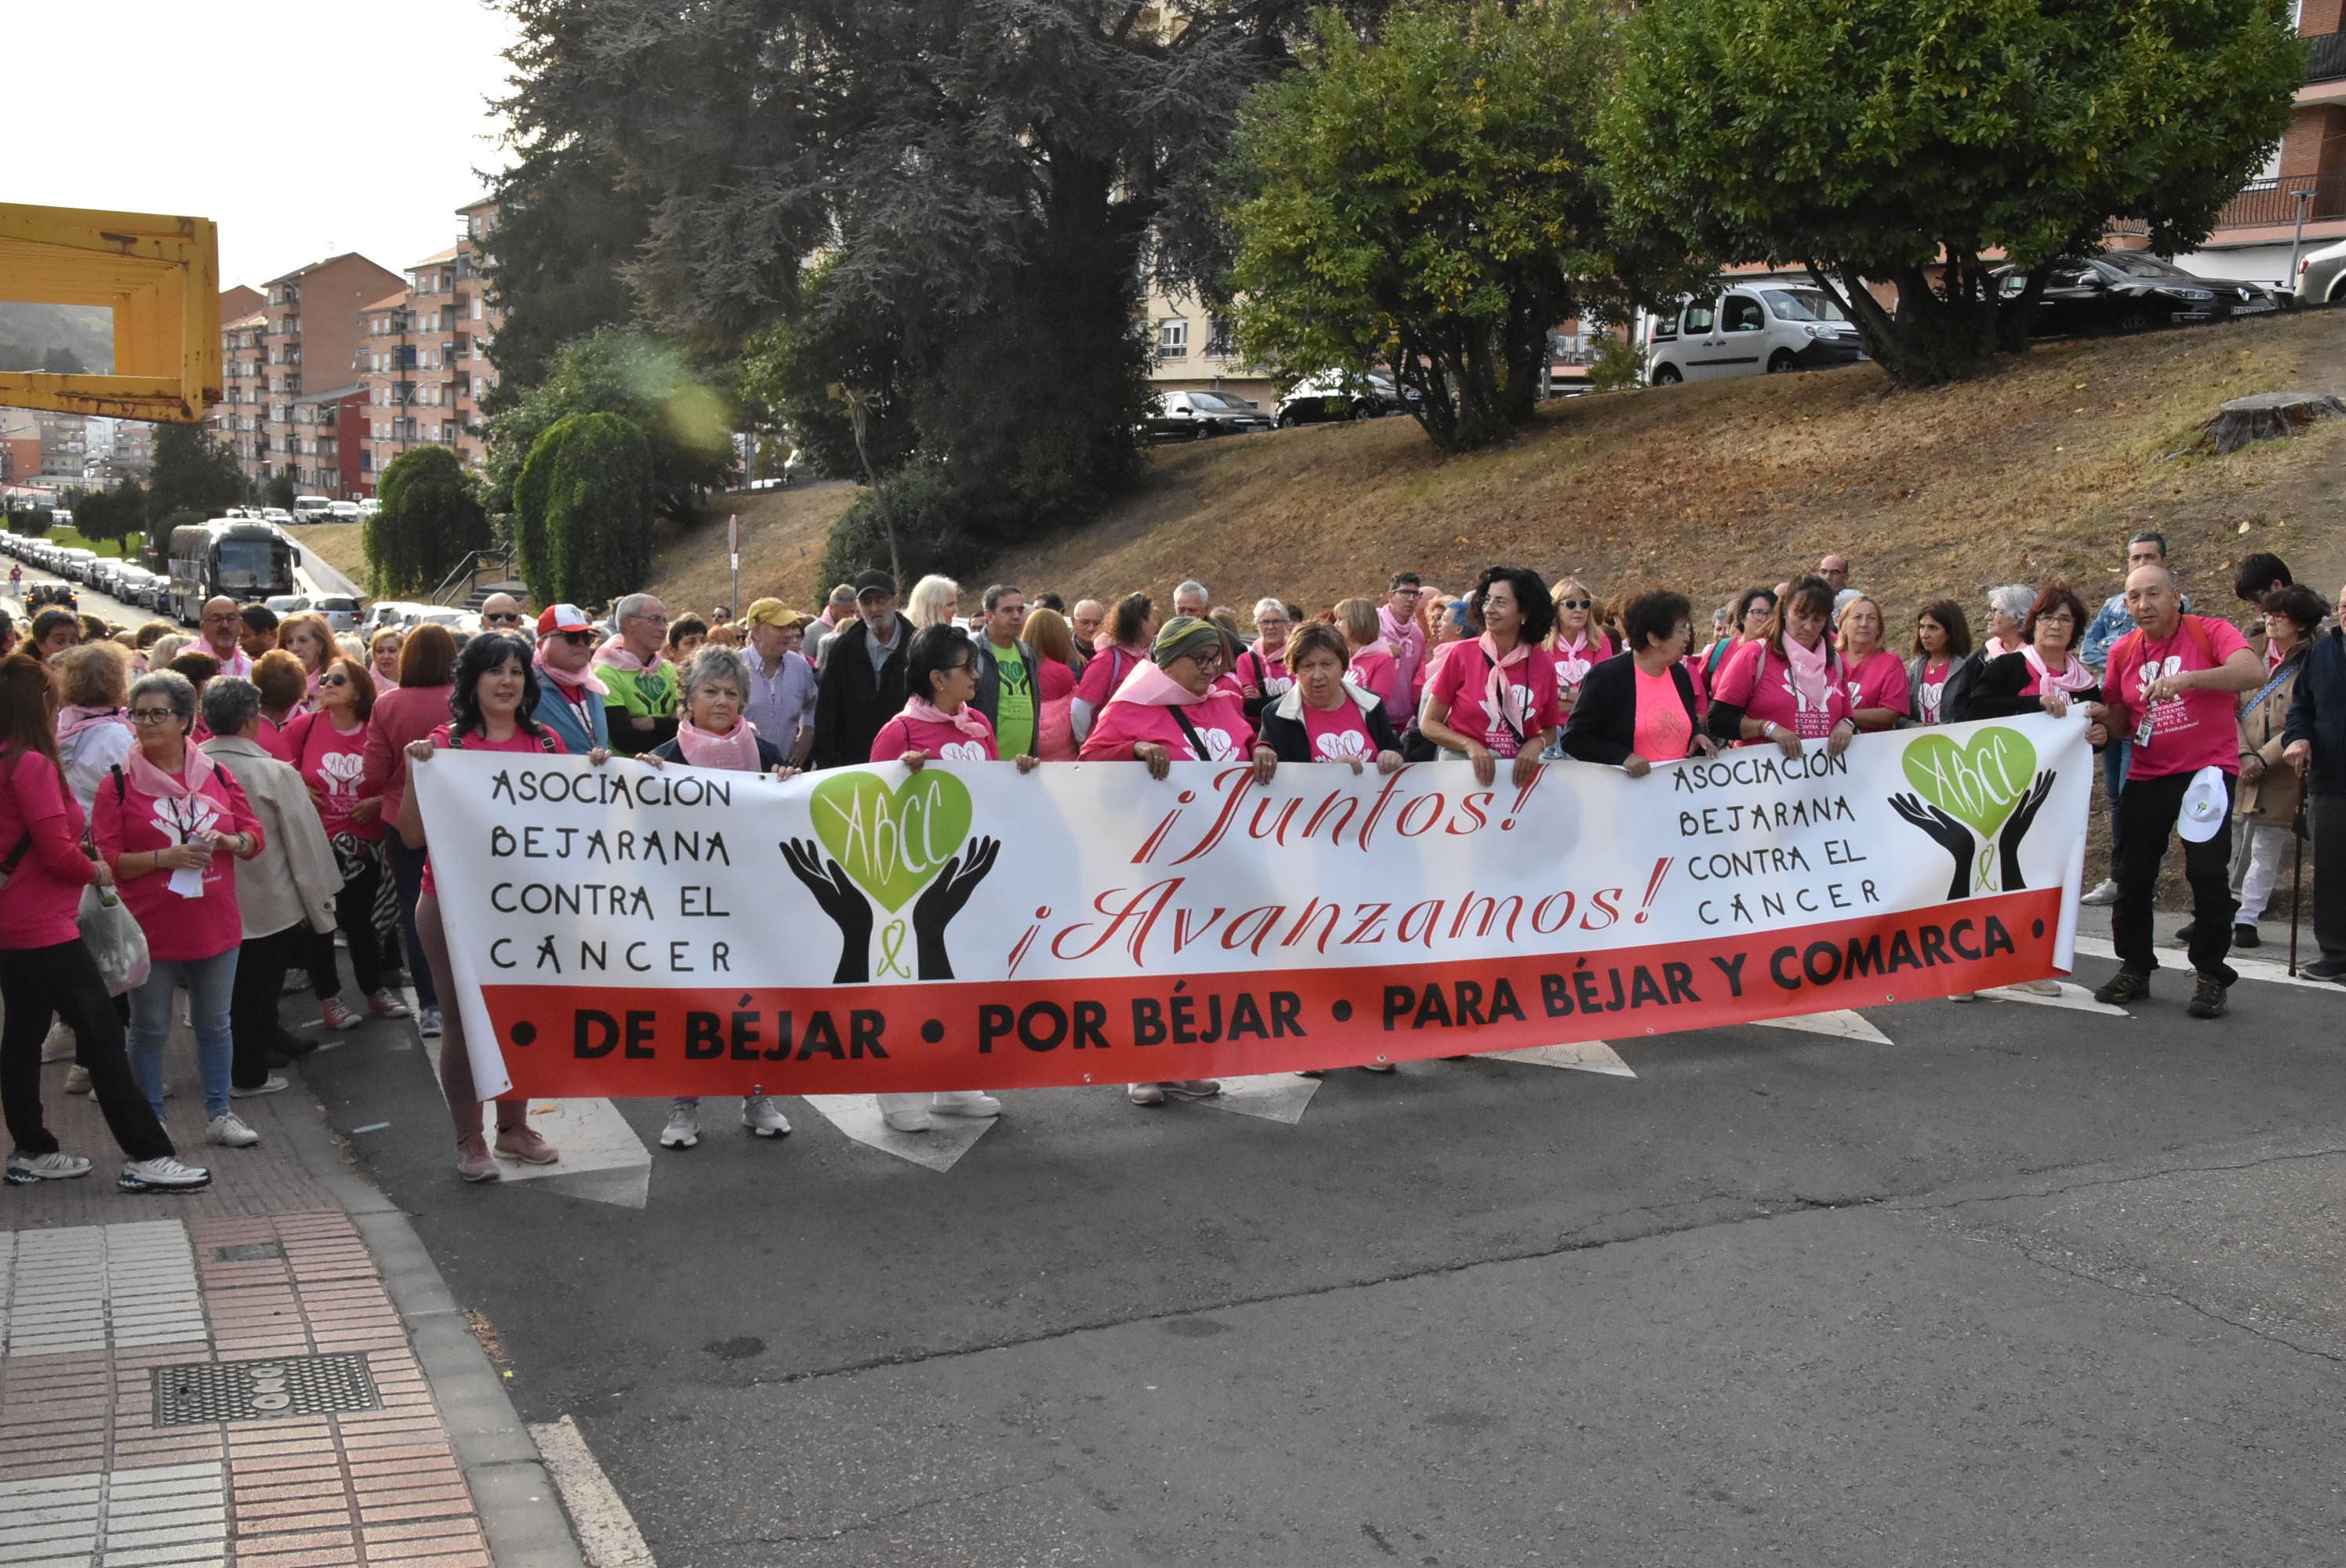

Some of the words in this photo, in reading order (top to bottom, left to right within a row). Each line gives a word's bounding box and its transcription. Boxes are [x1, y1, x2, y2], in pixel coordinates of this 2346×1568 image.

[492, 770, 730, 809] ASOCIACIÓN
[1672, 747, 1848, 793] ASOCIACIÓN
[1908, 734, 2025, 818] ABCC
[821, 779, 949, 887] ABCC
[1131, 763, 1550, 866] ¡Juntos!
[1680, 795, 1856, 837] BEJARANA
[492, 826, 730, 866] BEJARANA
[1688, 846, 1810, 880] CONTRA
[1825, 839, 1867, 865] EL
[491, 882, 654, 920] CONTRA
[681, 886, 730, 916] EL
[1008, 857, 1675, 980] ¡Avanzamos!
[1698, 879, 1881, 925] CÁNCER
[490, 935, 730, 974] CÁNCER
[573, 1008, 656, 1060] DE
[685, 993, 890, 1062] BÉJAR
[979, 1000, 1111, 1054] POR
[1131, 980, 1306, 1047] BÉJAR
[1382, 978, 1526, 1031] PARA
[1540, 956, 1701, 1018] BÉJAR
[1711, 953, 1747, 997] Y
[1770, 916, 2016, 990] COMARCA
